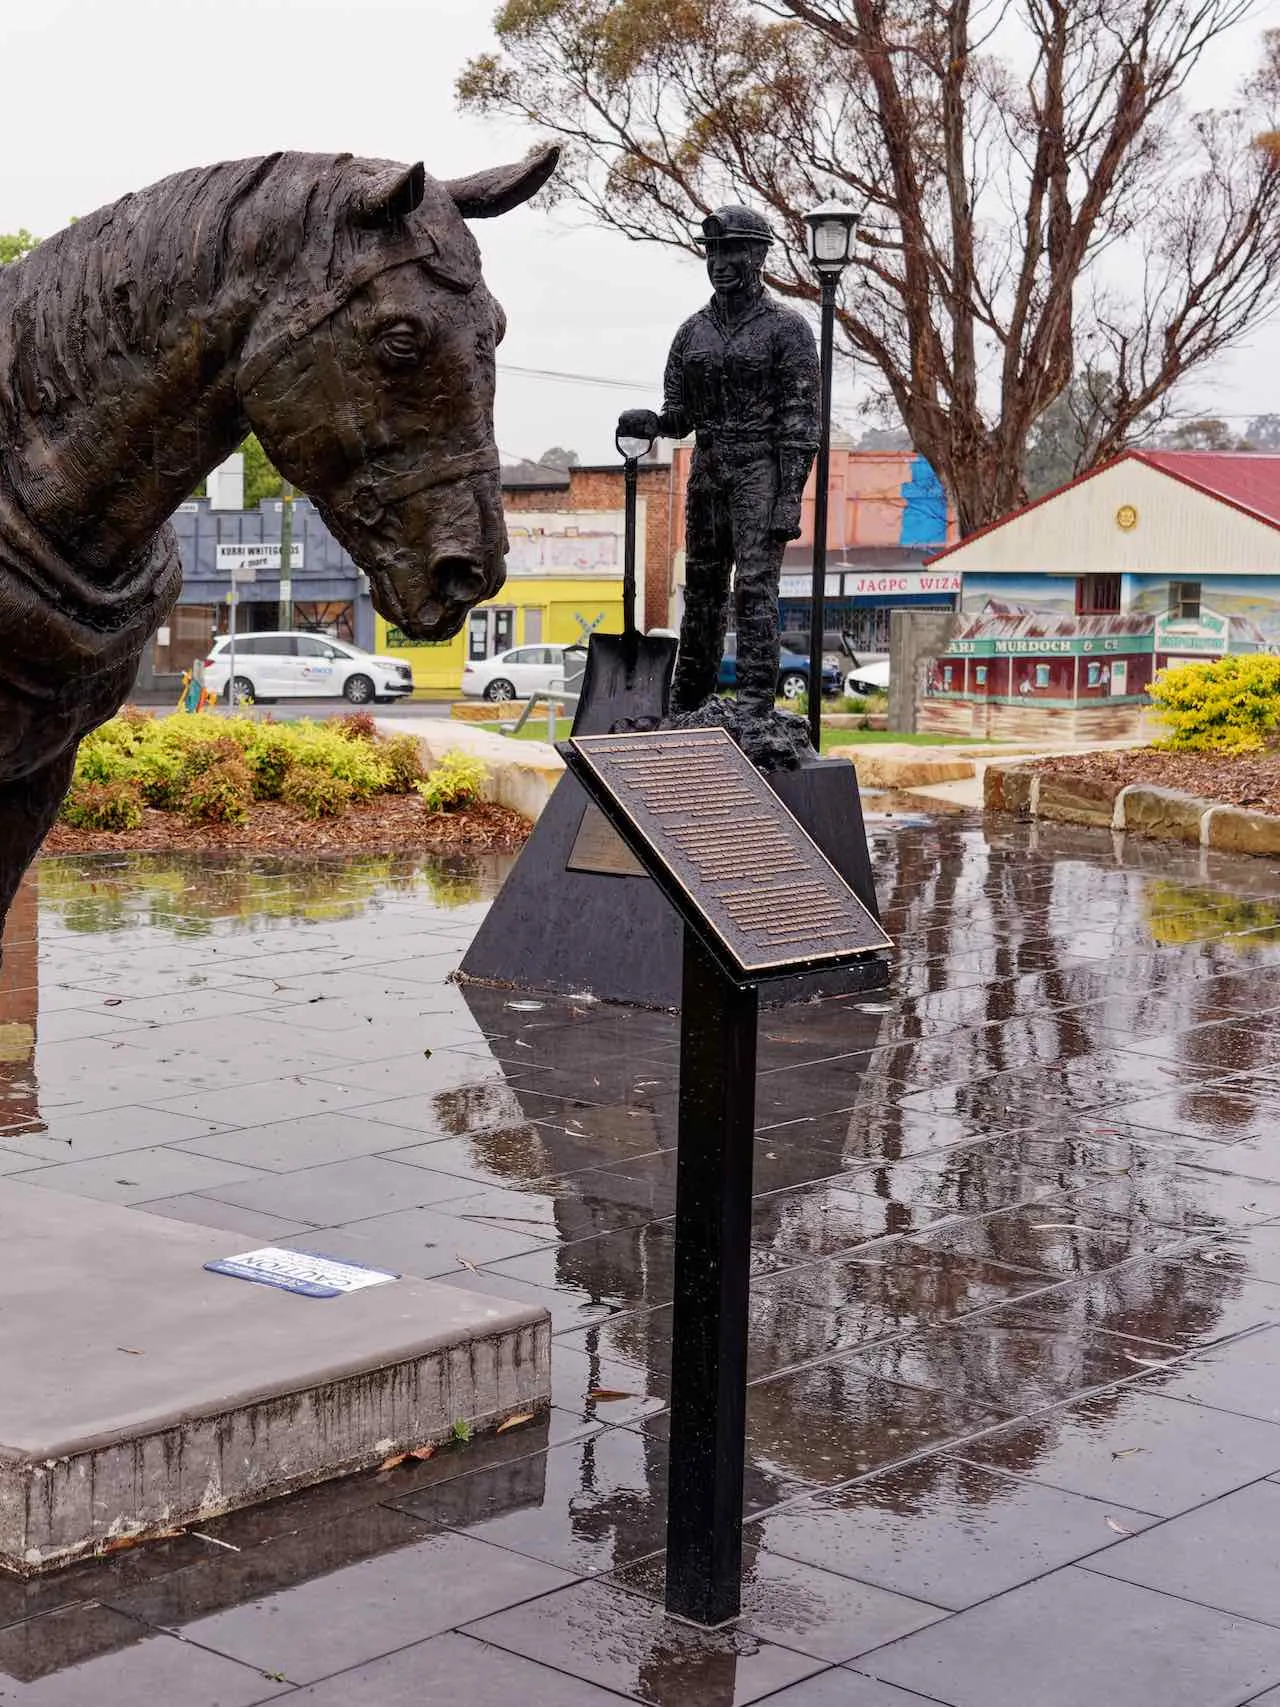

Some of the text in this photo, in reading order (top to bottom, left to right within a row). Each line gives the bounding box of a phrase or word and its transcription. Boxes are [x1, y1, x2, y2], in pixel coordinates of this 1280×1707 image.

[221, 545, 300, 556] KURRI WHITEGDS
[857, 578, 908, 593] JAGPC
[995, 640, 1071, 653] MURDOCH
[246, 1257, 352, 1287] CAUTION
